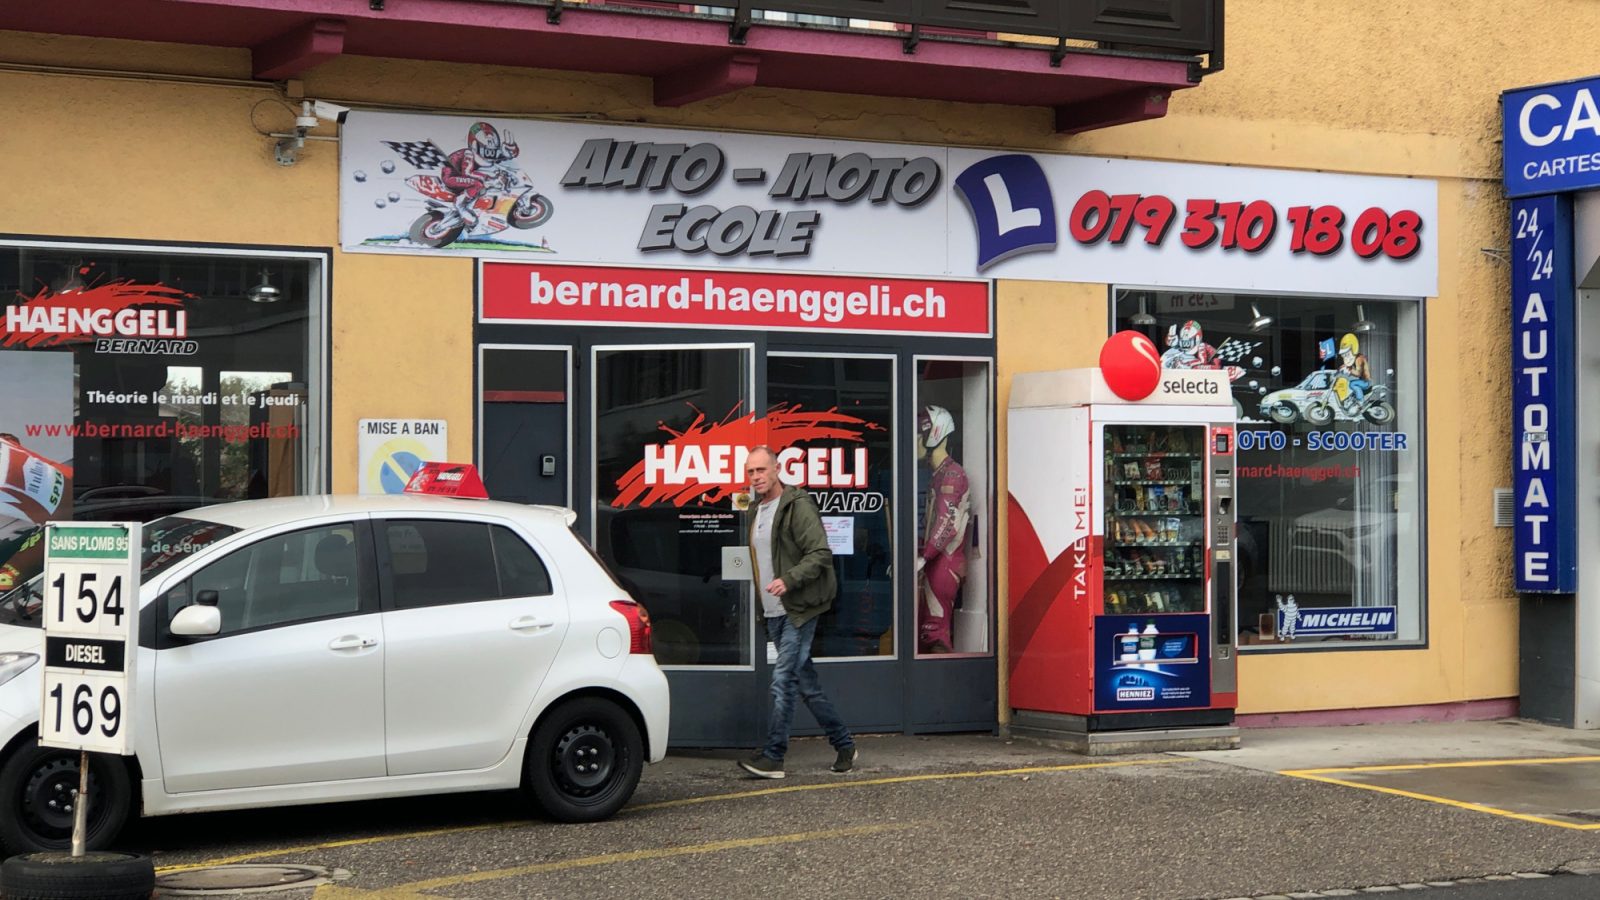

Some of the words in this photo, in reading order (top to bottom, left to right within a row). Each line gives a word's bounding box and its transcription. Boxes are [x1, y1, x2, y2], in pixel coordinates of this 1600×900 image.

[559, 138, 726, 195] AUTO
[768, 152, 942, 207] MOTO
[1523, 152, 1600, 180] CARTES
[983, 172, 1041, 237] L
[637, 203, 821, 258] ECOLE
[1068, 189, 1177, 245] 079
[1180, 198, 1278, 253] 310
[1287, 204, 1346, 256] 18
[1351, 206, 1424, 260] 08
[1516, 207, 1539, 239] 24
[1531, 249, 1553, 281] 24
[530, 271, 945, 322] bernard-haenggeli.ch
[6, 305, 187, 337] HAENGGELI
[95, 338, 199, 355] BERNARD
[86, 390, 148, 404] Théorie
[152, 391, 167, 404] le
[171, 392, 217, 405] mardi
[221, 394, 238, 405] et
[242, 393, 257, 406] le
[259, 393, 299, 408] jeudi
[1163, 377, 1219, 395] selecta
[25, 420, 299, 443] www.bernard-haenggeli.ch
[367, 422, 398, 435] MISE
[401, 422, 410, 434] A
[414, 422, 439, 435] BAN
[1237, 430, 1286, 450] OTO
[1307, 431, 1407, 451] SCOOTER
[1522, 293, 1550, 582] AUTOMATE
[644, 444, 868, 488] HAENGELI
[807, 491, 884, 513] NARD
[1074, 487, 1086, 530] ME!
[51, 535, 78, 551] SANS
[79, 536, 116, 552] PLOMB
[116, 538, 129, 552] 95
[151, 540, 170, 554] de
[1073, 537, 1086, 600] TAKE
[52, 572, 125, 626] 154
[1302, 612, 1392, 628] MICHELIN
[65, 644, 106, 664] DIESEL
[1119, 689, 1153, 698] HENNIEZ
[50, 682, 121, 738] 169
